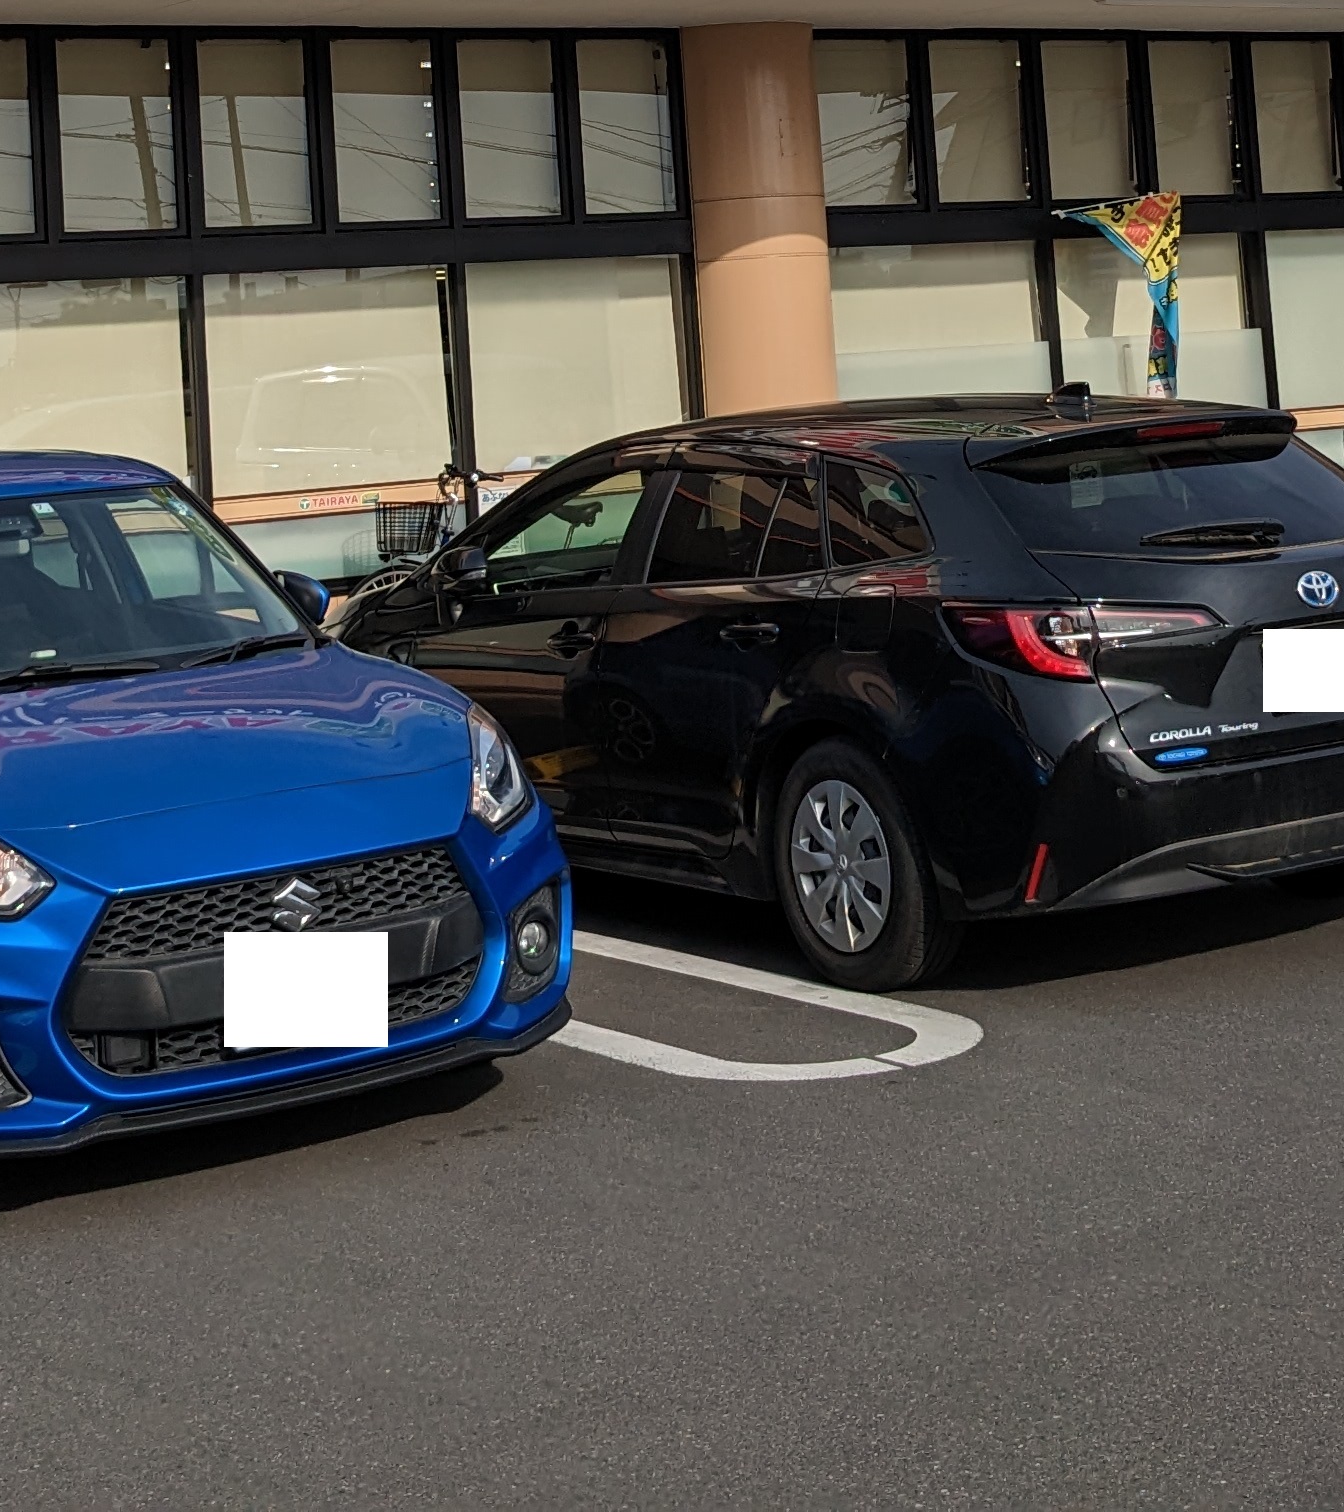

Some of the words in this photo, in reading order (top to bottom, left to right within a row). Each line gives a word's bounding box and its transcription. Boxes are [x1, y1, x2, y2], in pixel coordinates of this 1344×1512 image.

[312, 494, 359, 508] TAIRAYA
[1149, 725, 1212, 743] COROLLA
[1218, 721, 1259, 734] Touring
